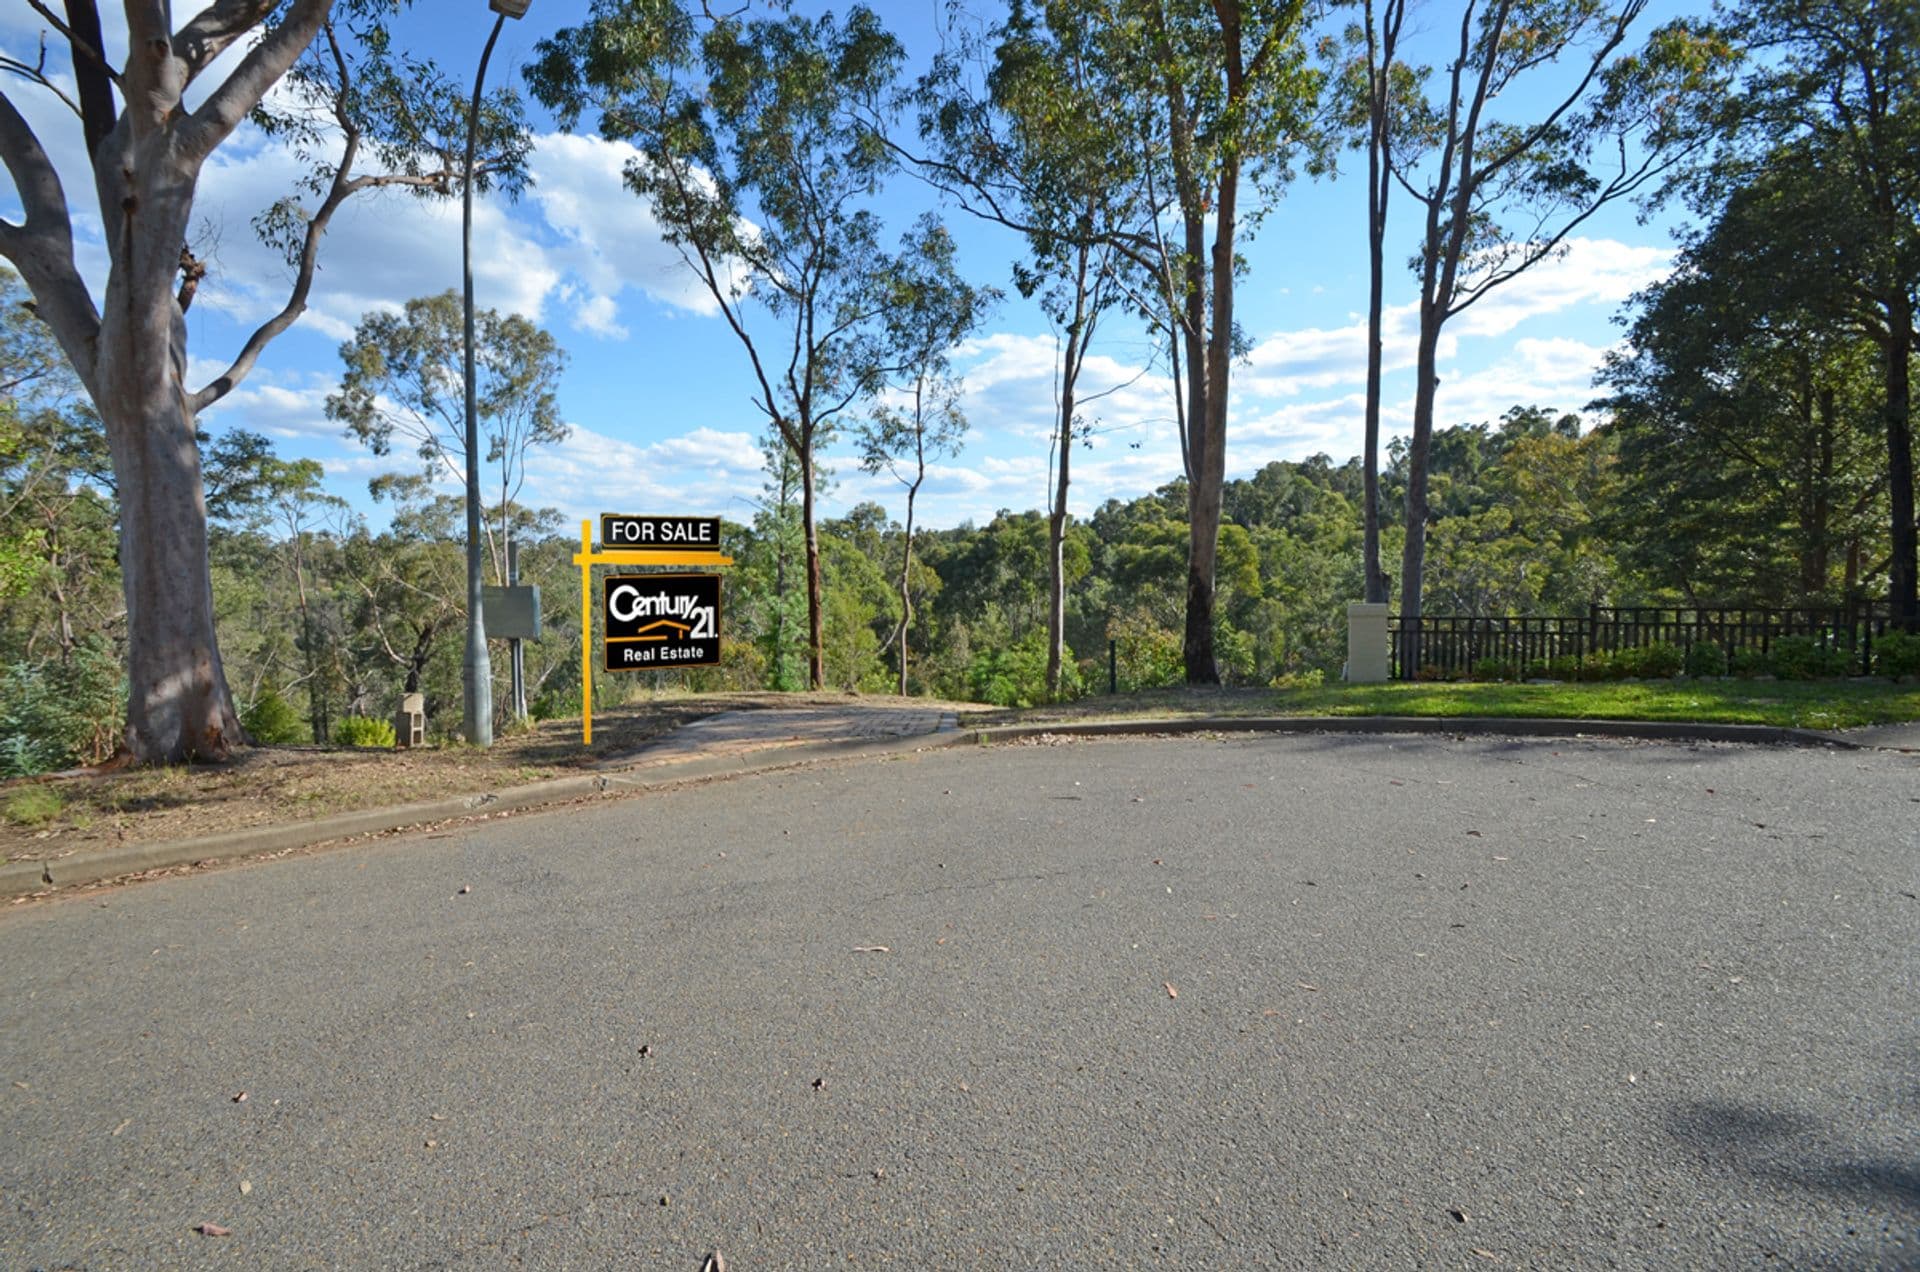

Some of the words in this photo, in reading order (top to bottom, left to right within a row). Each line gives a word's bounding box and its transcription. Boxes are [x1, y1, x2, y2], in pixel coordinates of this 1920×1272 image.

[612, 521, 655, 541] FOR
[660, 522, 712, 541] SALE
[609, 585, 699, 622] Century
[624, 648, 655, 662] Real
[660, 646, 704, 660] Estate
